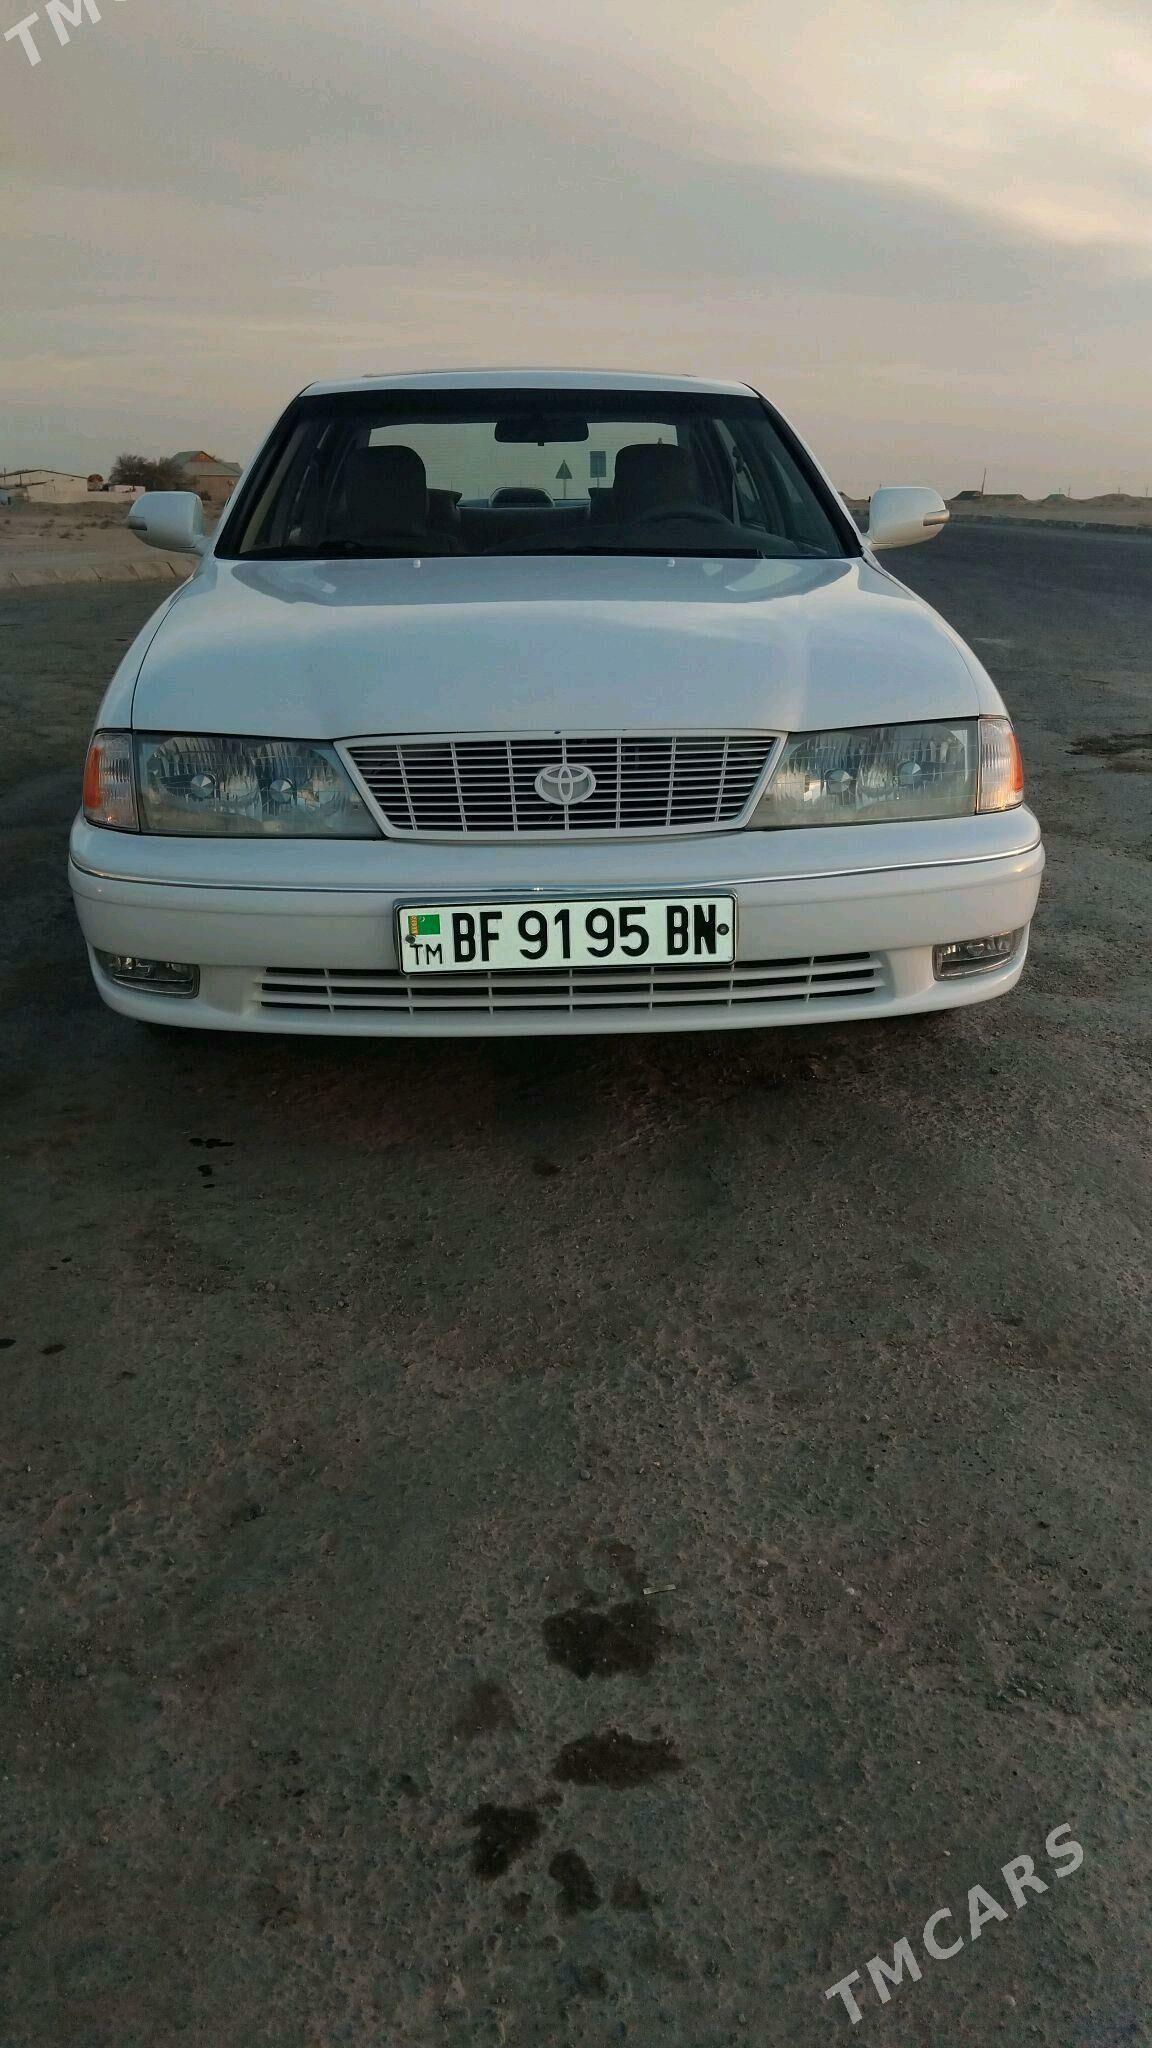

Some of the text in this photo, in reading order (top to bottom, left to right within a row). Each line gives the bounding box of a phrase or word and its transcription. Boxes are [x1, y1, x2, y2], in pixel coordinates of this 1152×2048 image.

[452, 904, 717, 963] BF 9195 BN
[410, 943, 443, 966] TM
